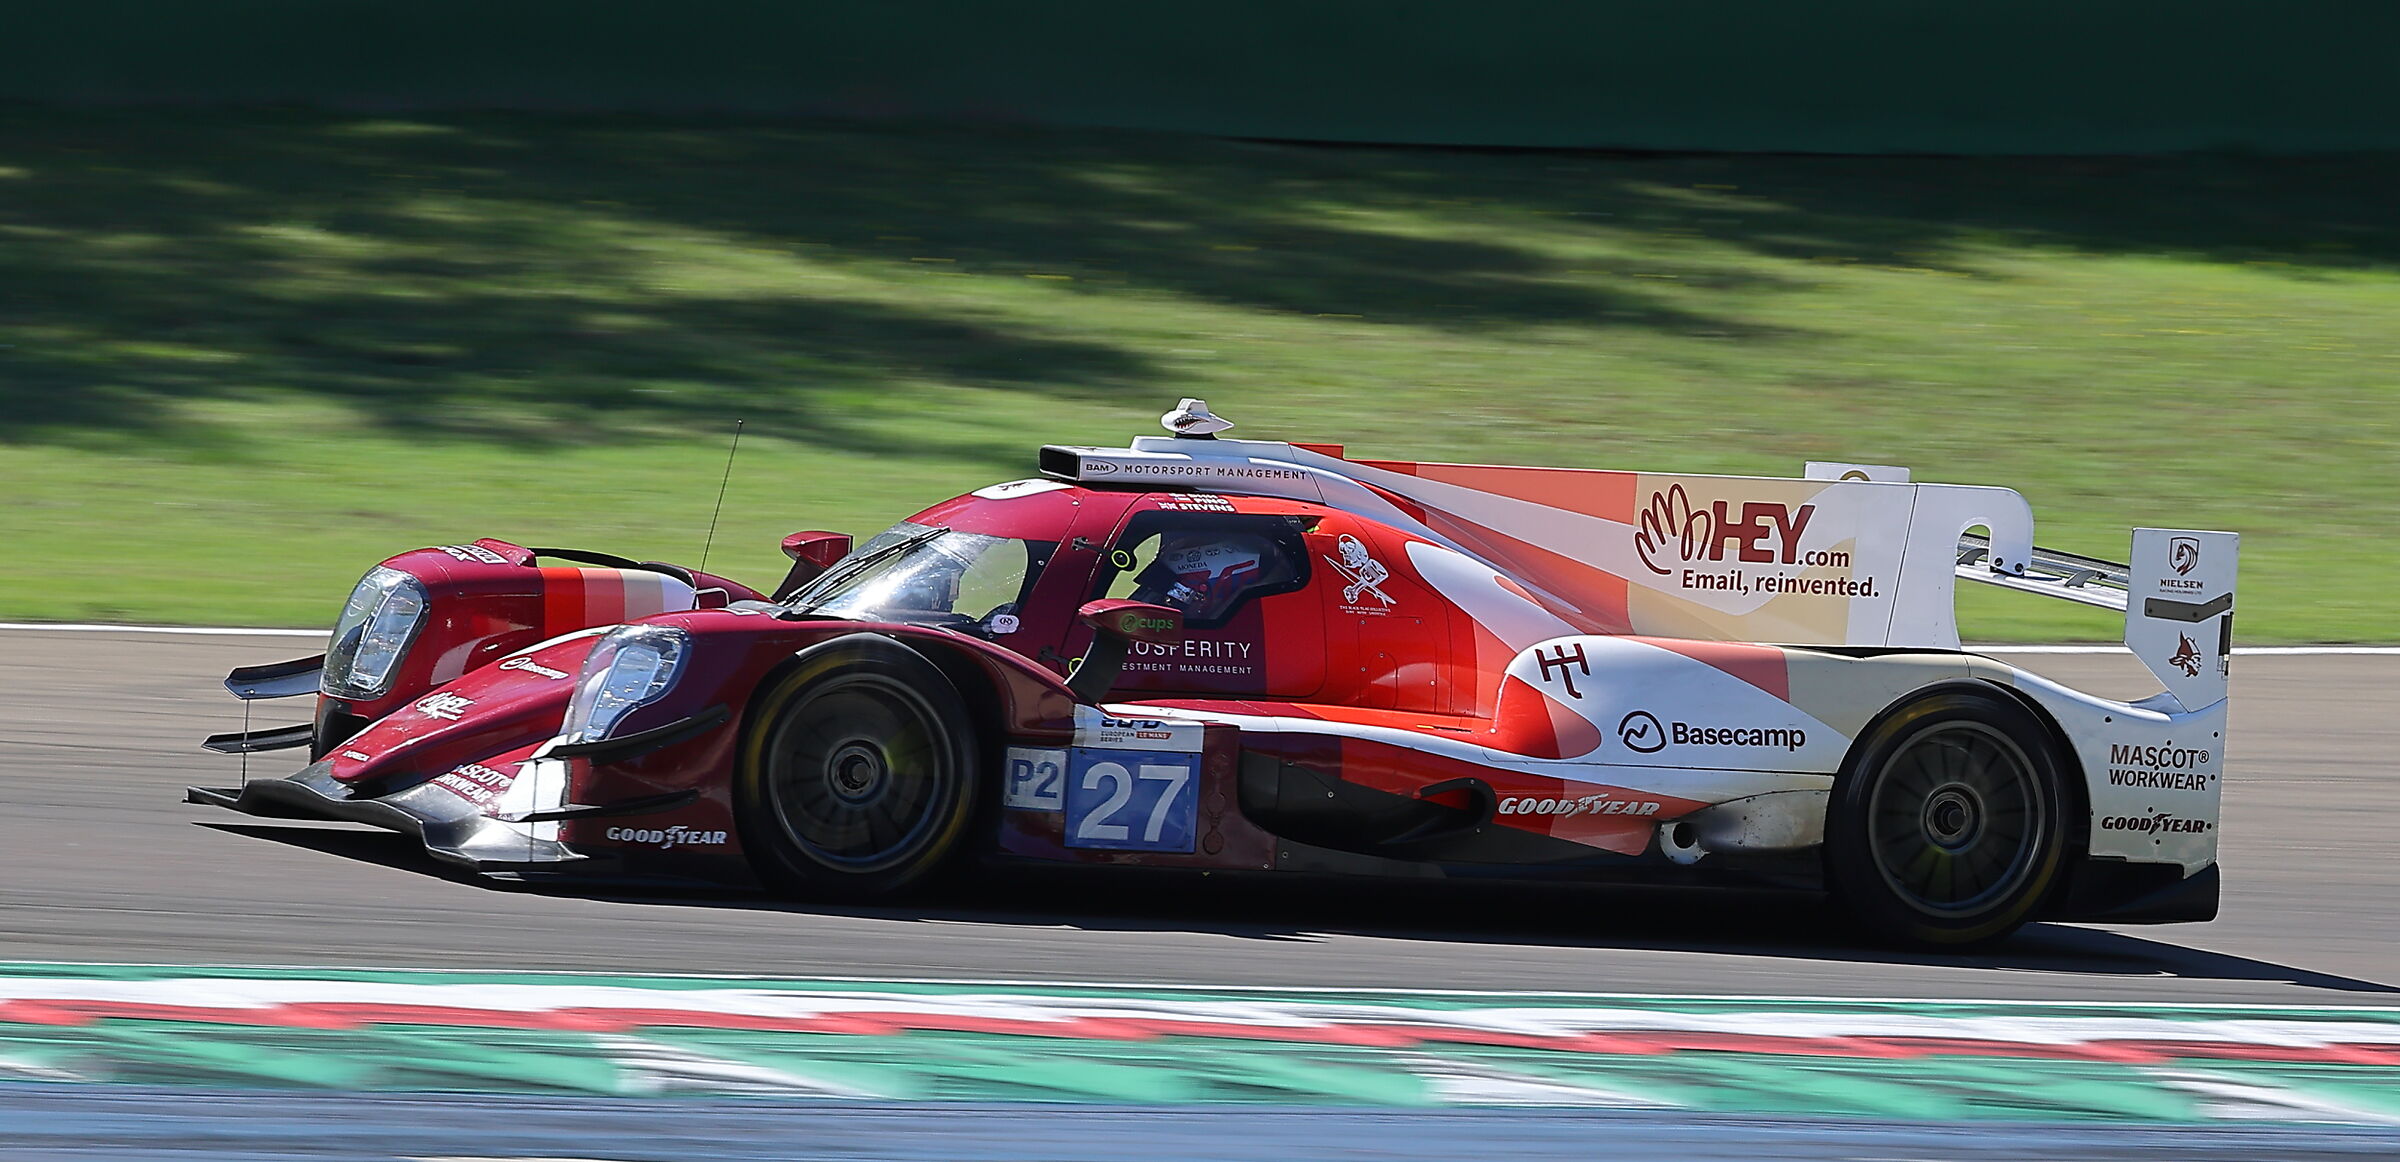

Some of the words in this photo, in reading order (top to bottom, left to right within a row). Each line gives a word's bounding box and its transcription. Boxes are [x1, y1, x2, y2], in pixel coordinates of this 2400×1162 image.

[1085, 463, 1109, 472] BAM
[1124, 465, 1211, 476] MOTORSPORT
[1217, 467, 1307, 480] MANAGEMENT
[1178, 503, 1236, 512] STEVENS
[1681, 569, 1750, 596] Email,
[1755, 571, 1880, 598] reinvented.
[2160, 578, 2204, 589] NIELSEN
[1137, 618, 1174, 633] cups
[1127, 640, 1251, 659] OSPERITY
[1121, 662, 1172, 672] ESTMENT
[1179, 664, 1252, 675] MANAGEMENT
[1671, 721, 1806, 752] Basecamp
[1010, 758, 1059, 799] P2
[2108, 768, 2207, 792] WORKWEAR
[1077, 761, 1191, 843] 27
[1498, 793, 1660, 819] GOODYEAR
[2101, 813, 2206, 836] GOODYEAR
[605, 825, 728, 850] GOODYEAR
